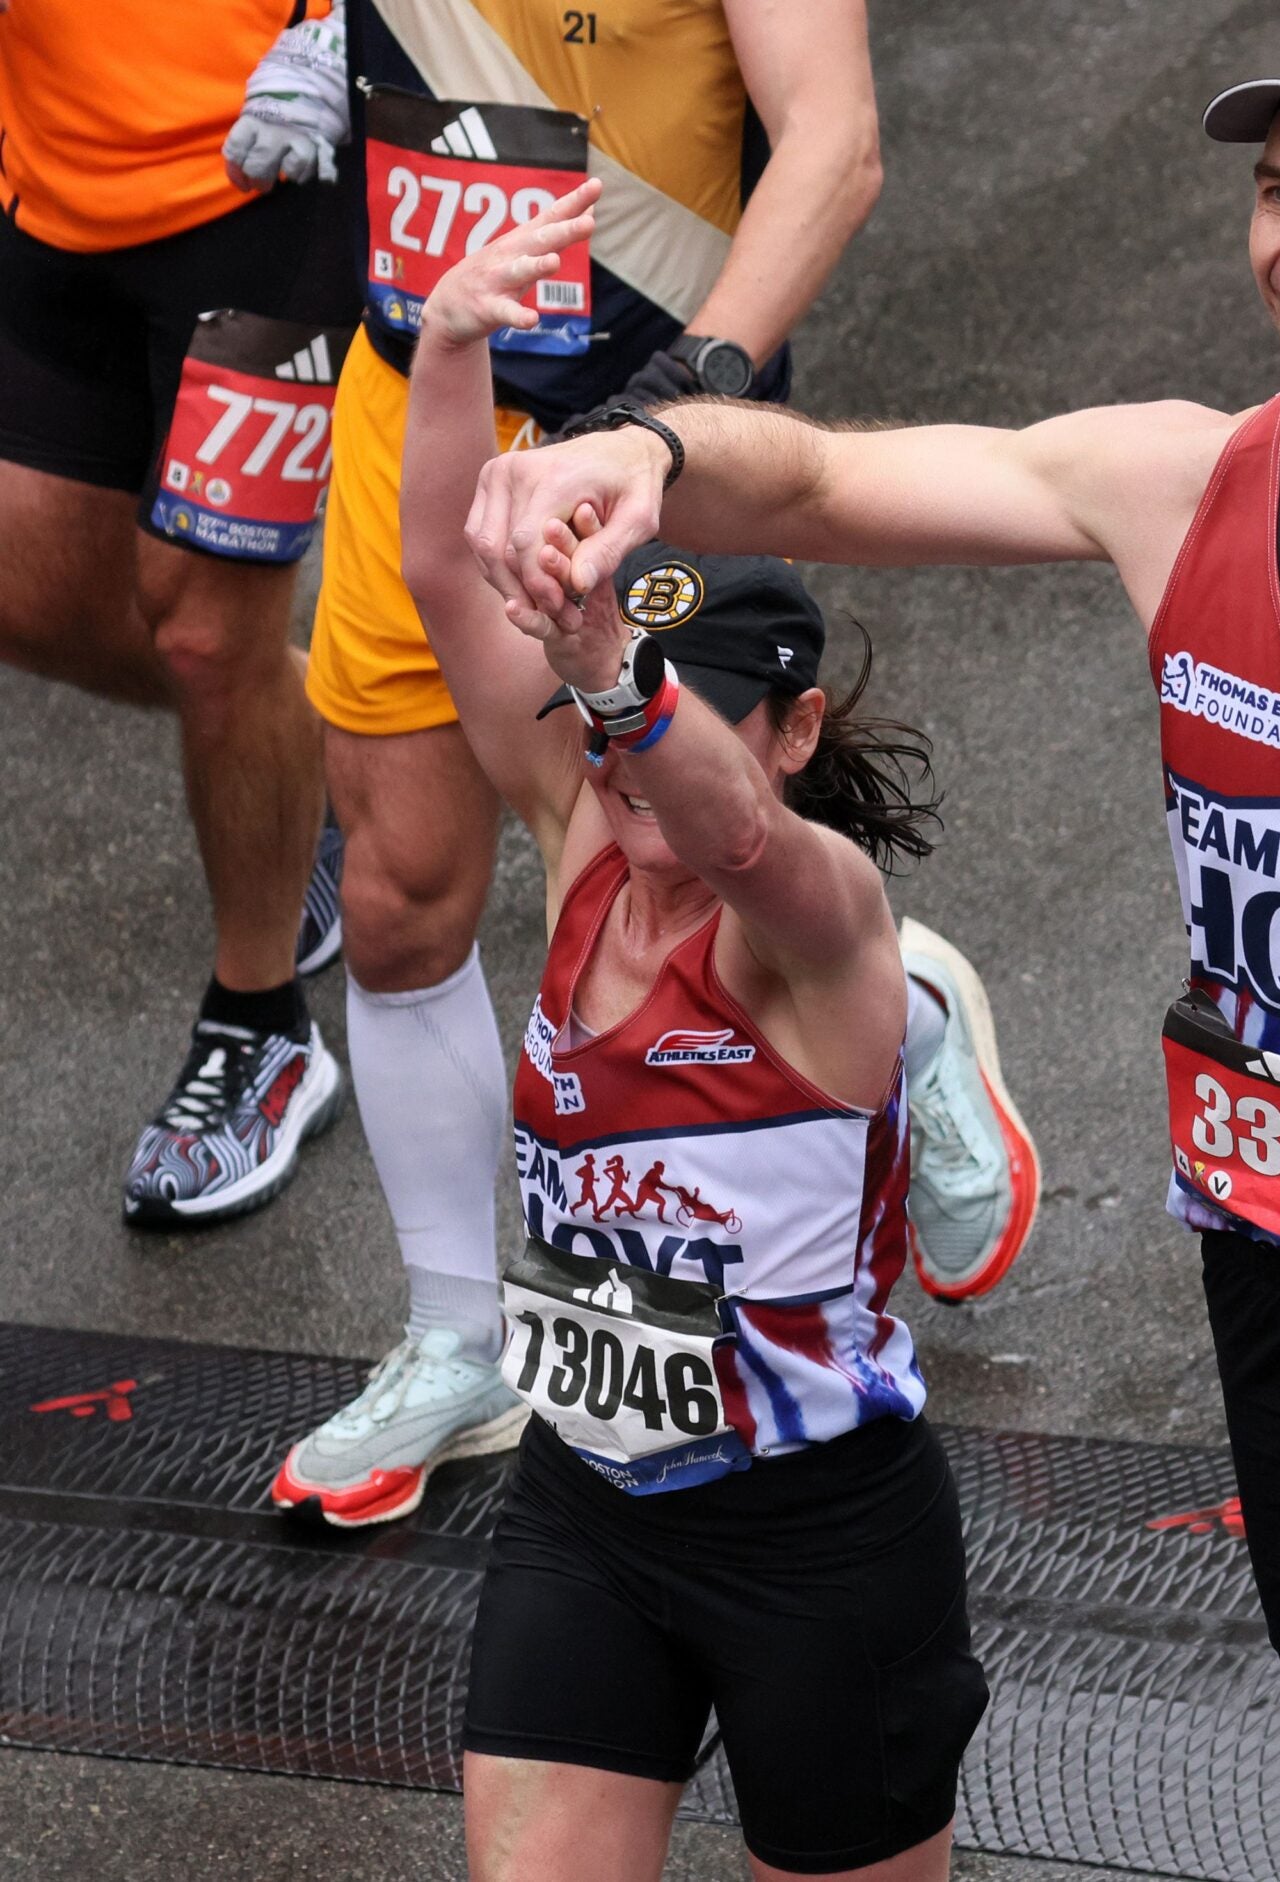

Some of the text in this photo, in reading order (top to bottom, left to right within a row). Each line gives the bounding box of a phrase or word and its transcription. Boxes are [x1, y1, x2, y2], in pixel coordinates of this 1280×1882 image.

[563, 10, 596, 44] 21
[194, 525, 278, 552] MARATHON
[228, 522, 280, 540] BOSTON
[1200, 669, 1269, 711] THOMAS
[1180, 793, 1280, 878] EAM
[648, 1048, 753, 1063] ATHLETICS EAST
[515, 1134, 568, 1213] EAM
[1178, 1154, 1188, 1168] 4
[1213, 1176, 1228, 1195] V
[515, 1310, 719, 1436] 13046
